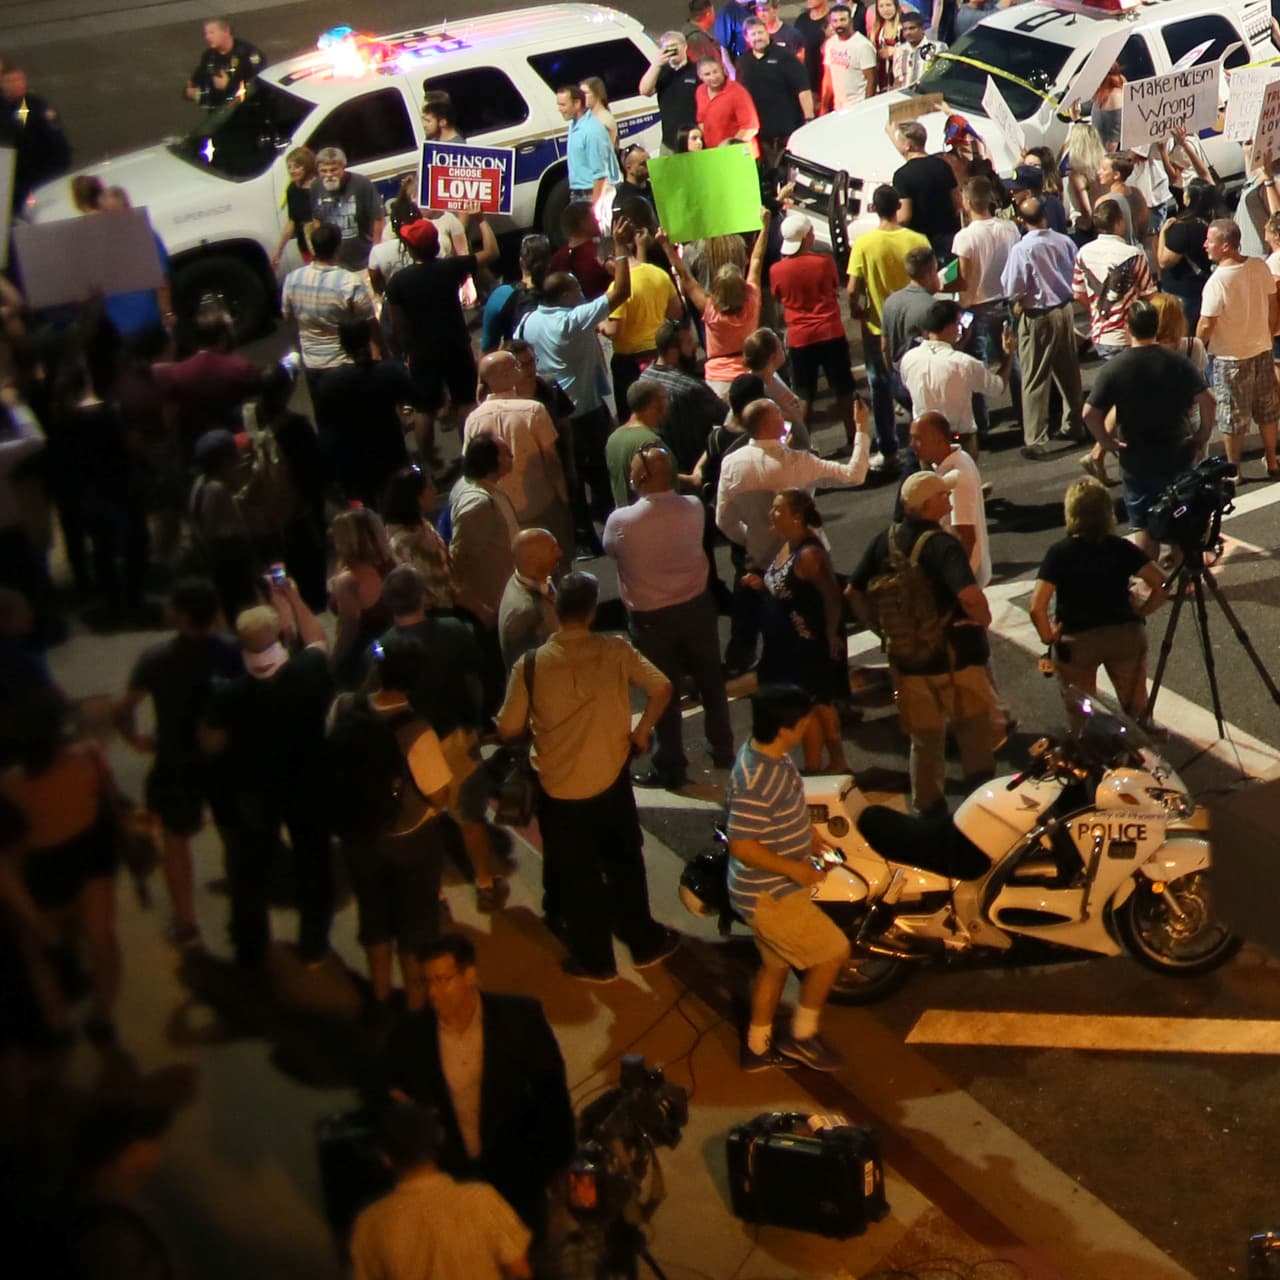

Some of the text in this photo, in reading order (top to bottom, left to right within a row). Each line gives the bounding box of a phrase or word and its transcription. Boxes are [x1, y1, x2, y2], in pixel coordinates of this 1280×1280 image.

[1130, 67, 1214, 102] Make racism
[1137, 93, 1195, 122] Wrong
[431, 150, 507, 173] JOHNSON
[448, 167, 483, 178] CHOOSE
[437, 178, 492, 200] LOVE
[1078, 823, 1148, 841] POLICE
